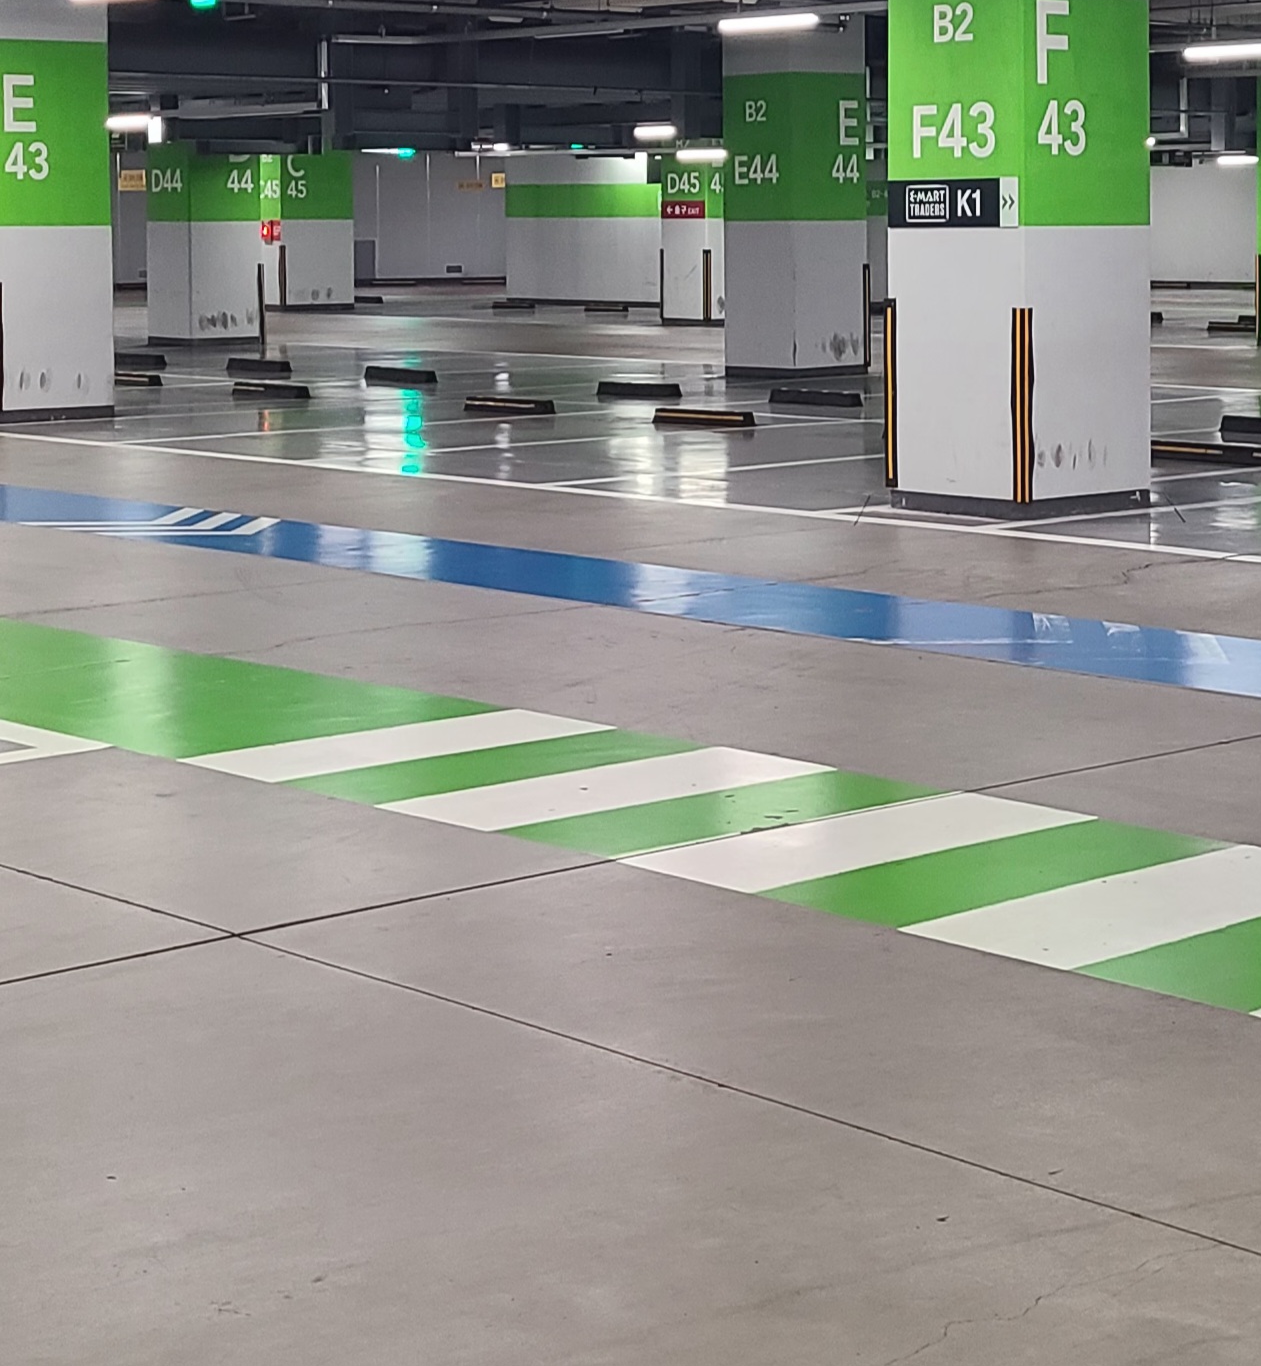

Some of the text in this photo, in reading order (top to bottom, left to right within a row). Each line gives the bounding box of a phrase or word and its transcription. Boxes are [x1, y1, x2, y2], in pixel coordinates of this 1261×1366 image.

[933, 2, 974, 43] B2
[3, 74, 37, 132] E
[745, 100, 767, 122] B2
[839, 100, 859, 145] E
[913, 101, 996, 158] F43
[1038, 100, 1086, 156] 43
[5, 141, 49, 180] 43
[734, 153, 779, 184] E44
[832, 154, 860, 183] 44
[151, 168, 182, 193] D44
[227, 169, 254, 193] 44
[287, 180, 307, 198] 45
[667, 172, 700, 194] D45
[909, 203, 945, 217] TRADERS
[957, 189, 981, 217] K1
